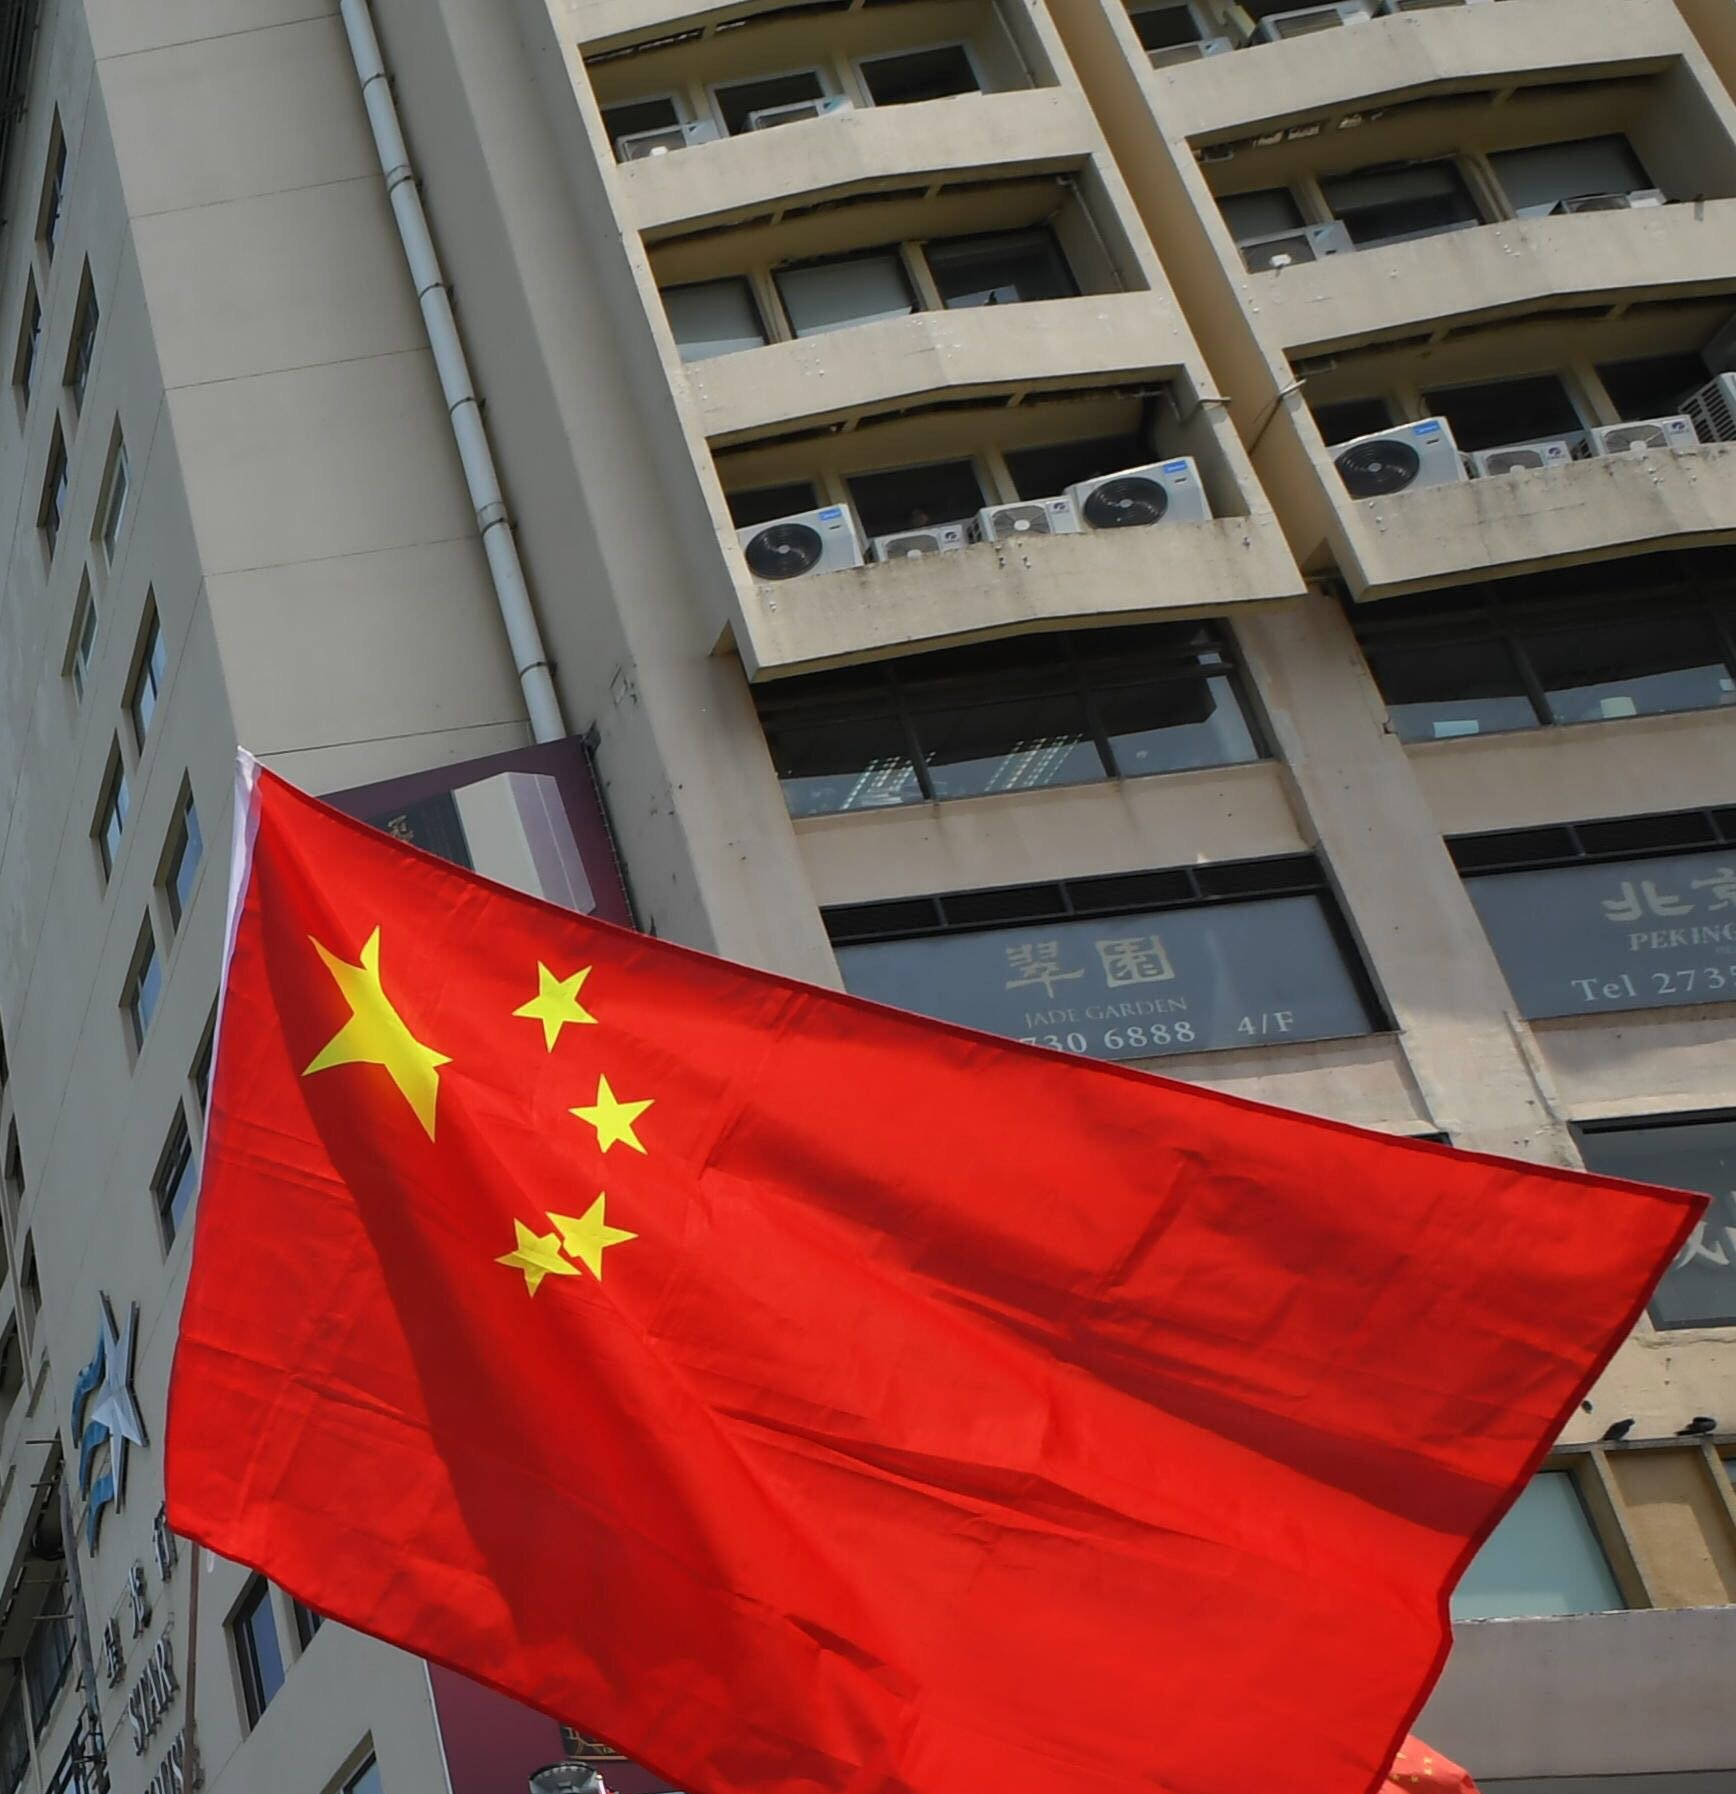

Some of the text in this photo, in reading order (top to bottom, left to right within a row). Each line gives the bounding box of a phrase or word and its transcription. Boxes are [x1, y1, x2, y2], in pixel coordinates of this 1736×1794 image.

[1571, 974, 1636, 1001] Tel
[1025, 996, 1188, 1029] JADE GARDEN
[1104, 1021, 1195, 1050] 6888
[1237, 1011, 1295, 1037] 4/F
[129, 1638, 178, 1757] STAR
